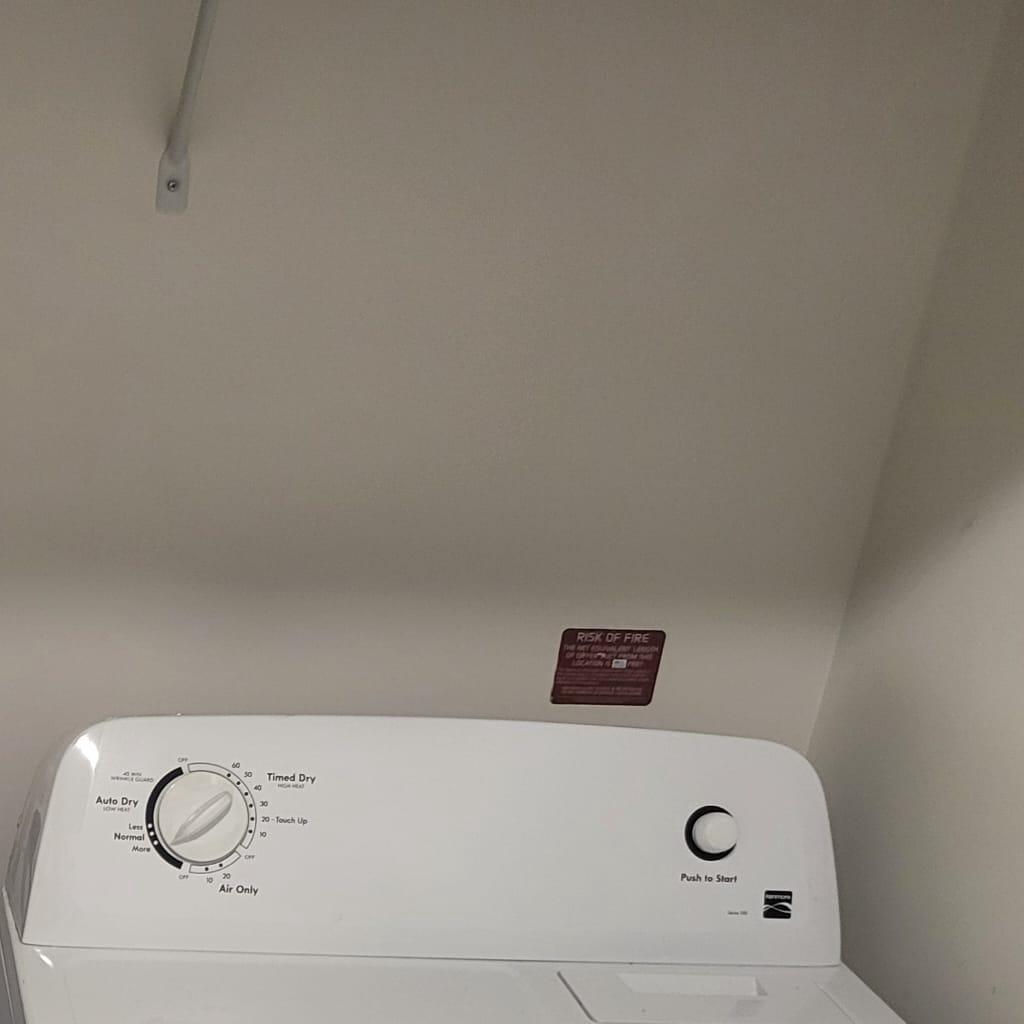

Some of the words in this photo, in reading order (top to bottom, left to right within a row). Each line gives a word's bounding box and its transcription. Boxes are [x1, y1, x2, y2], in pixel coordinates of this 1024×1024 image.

[577, 632, 603, 642] RISK
[605, 633, 621, 642] OF
[624, 634, 650, 643] FIRE
[267, 772, 296, 782] Timed
[298, 773, 316, 784] Dry
[96, 795, 118, 805] Auto
[121, 797, 139, 808] Dry
[275, 816, 296, 824] Touch
[297, 818, 308, 826] Up
[114, 832, 145, 841] Normal
[680, 873, 702, 882] Push
[716, 874, 738, 883] Start
[219, 884, 233, 893] Air
[235, 885, 259, 896] Only
